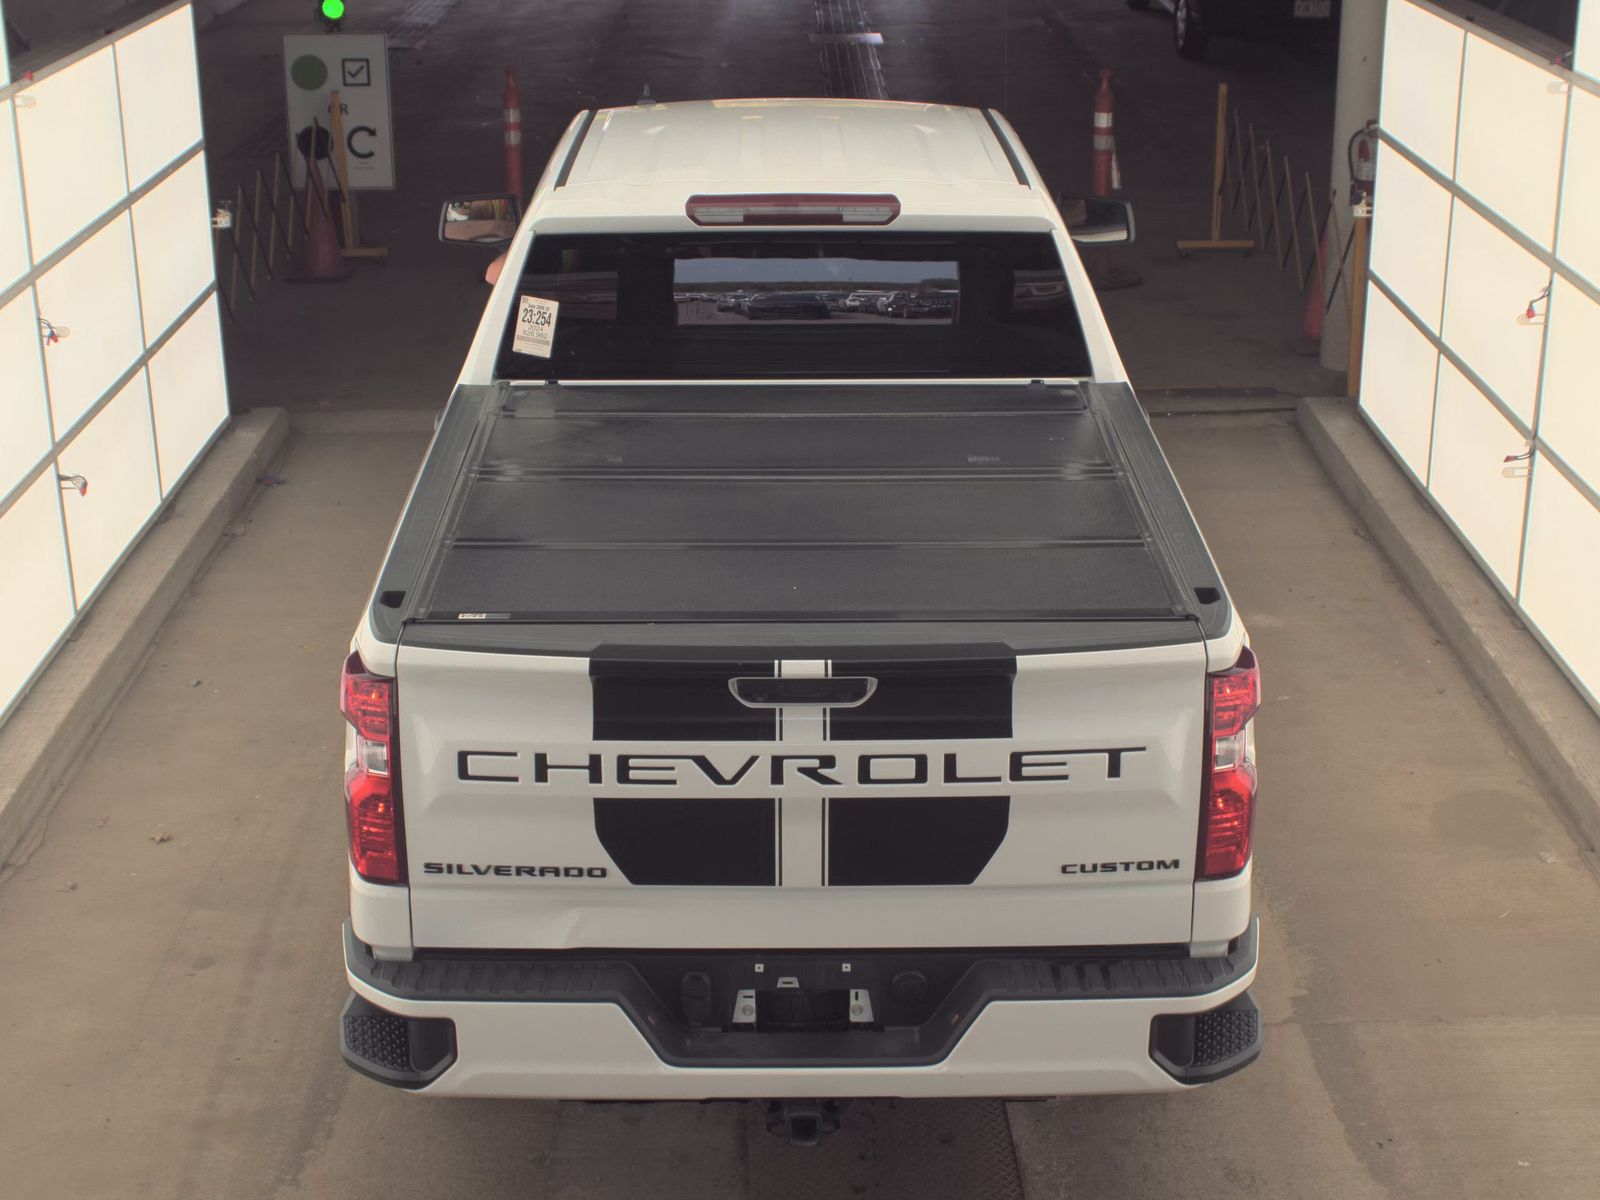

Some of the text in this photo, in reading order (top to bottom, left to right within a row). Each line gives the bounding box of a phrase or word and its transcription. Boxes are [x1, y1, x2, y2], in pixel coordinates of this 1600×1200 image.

[521, 307, 552, 328] 23:254
[457, 746, 1147, 786] CHEVROLET
[423, 862, 607, 879] SILVERADO
[1061, 859, 1180, 875] CUSTOM
